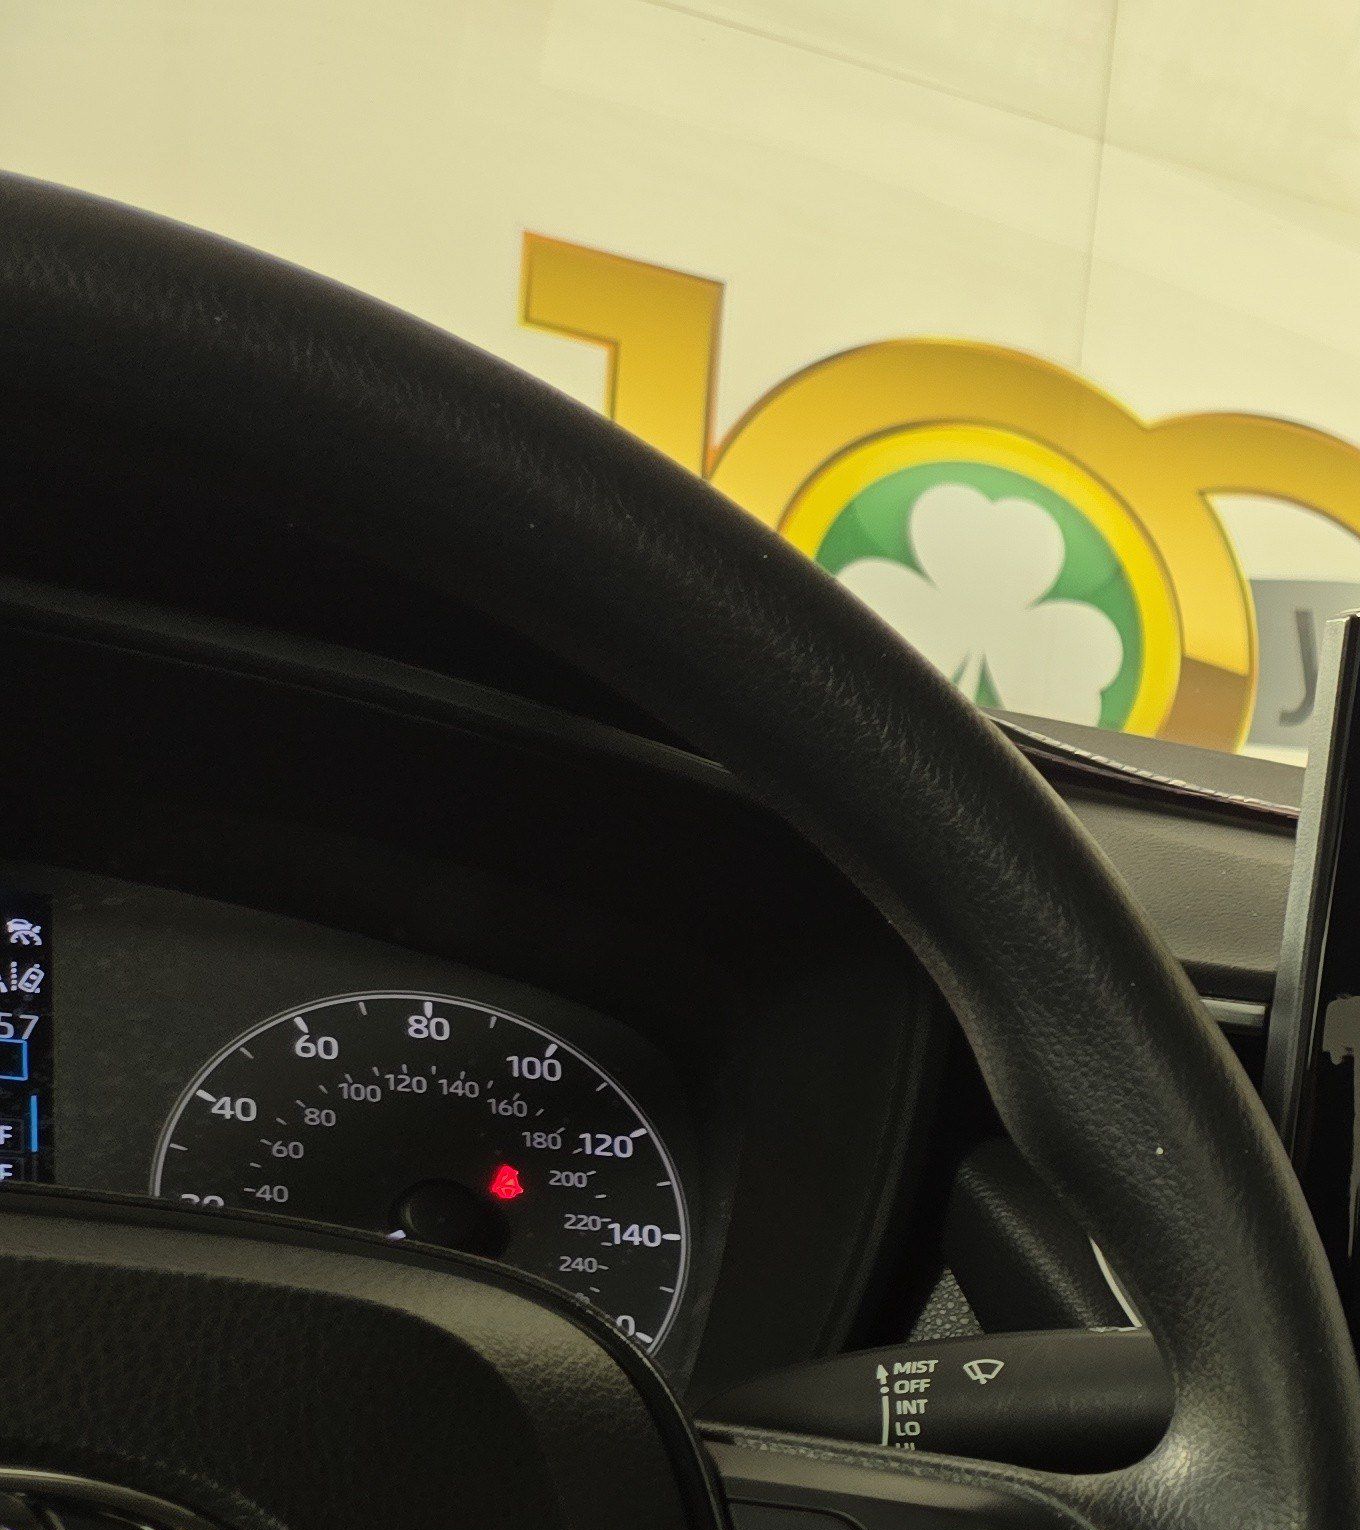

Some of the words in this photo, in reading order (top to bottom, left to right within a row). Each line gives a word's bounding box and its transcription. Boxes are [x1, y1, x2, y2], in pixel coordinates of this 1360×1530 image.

[407, 1014, 450, 1042] 80
[294, 1035, 339, 1060] 60
[506, 1055, 561, 1081] 100
[338, 1081, 381, 1103] 100
[385, 1072, 427, 1094] 120
[438, 1077, 479, 1099] 140
[211, 1096, 257, 1121] 40
[304, 1108, 336, 1127] 80
[488, 1098, 528, 1118] 160
[271, 1140, 304, 1159] 60
[522, 1131, 561, 1150] 180
[578, 1132, 633, 1158] 120
[549, 1169, 587, 1188] 200
[255, 1184, 289, 1203] 40
[564, 1213, 601, 1231] 220
[607, 1222, 662, 1248] 140
[559, 1256, 598, 1273] 240
[893, 1359, 939, 1375] MIST
[893, 1378, 931, 1394] OFF
[896, 1398, 928, 1415] INT
[895, 1421, 920, 1436] LO
